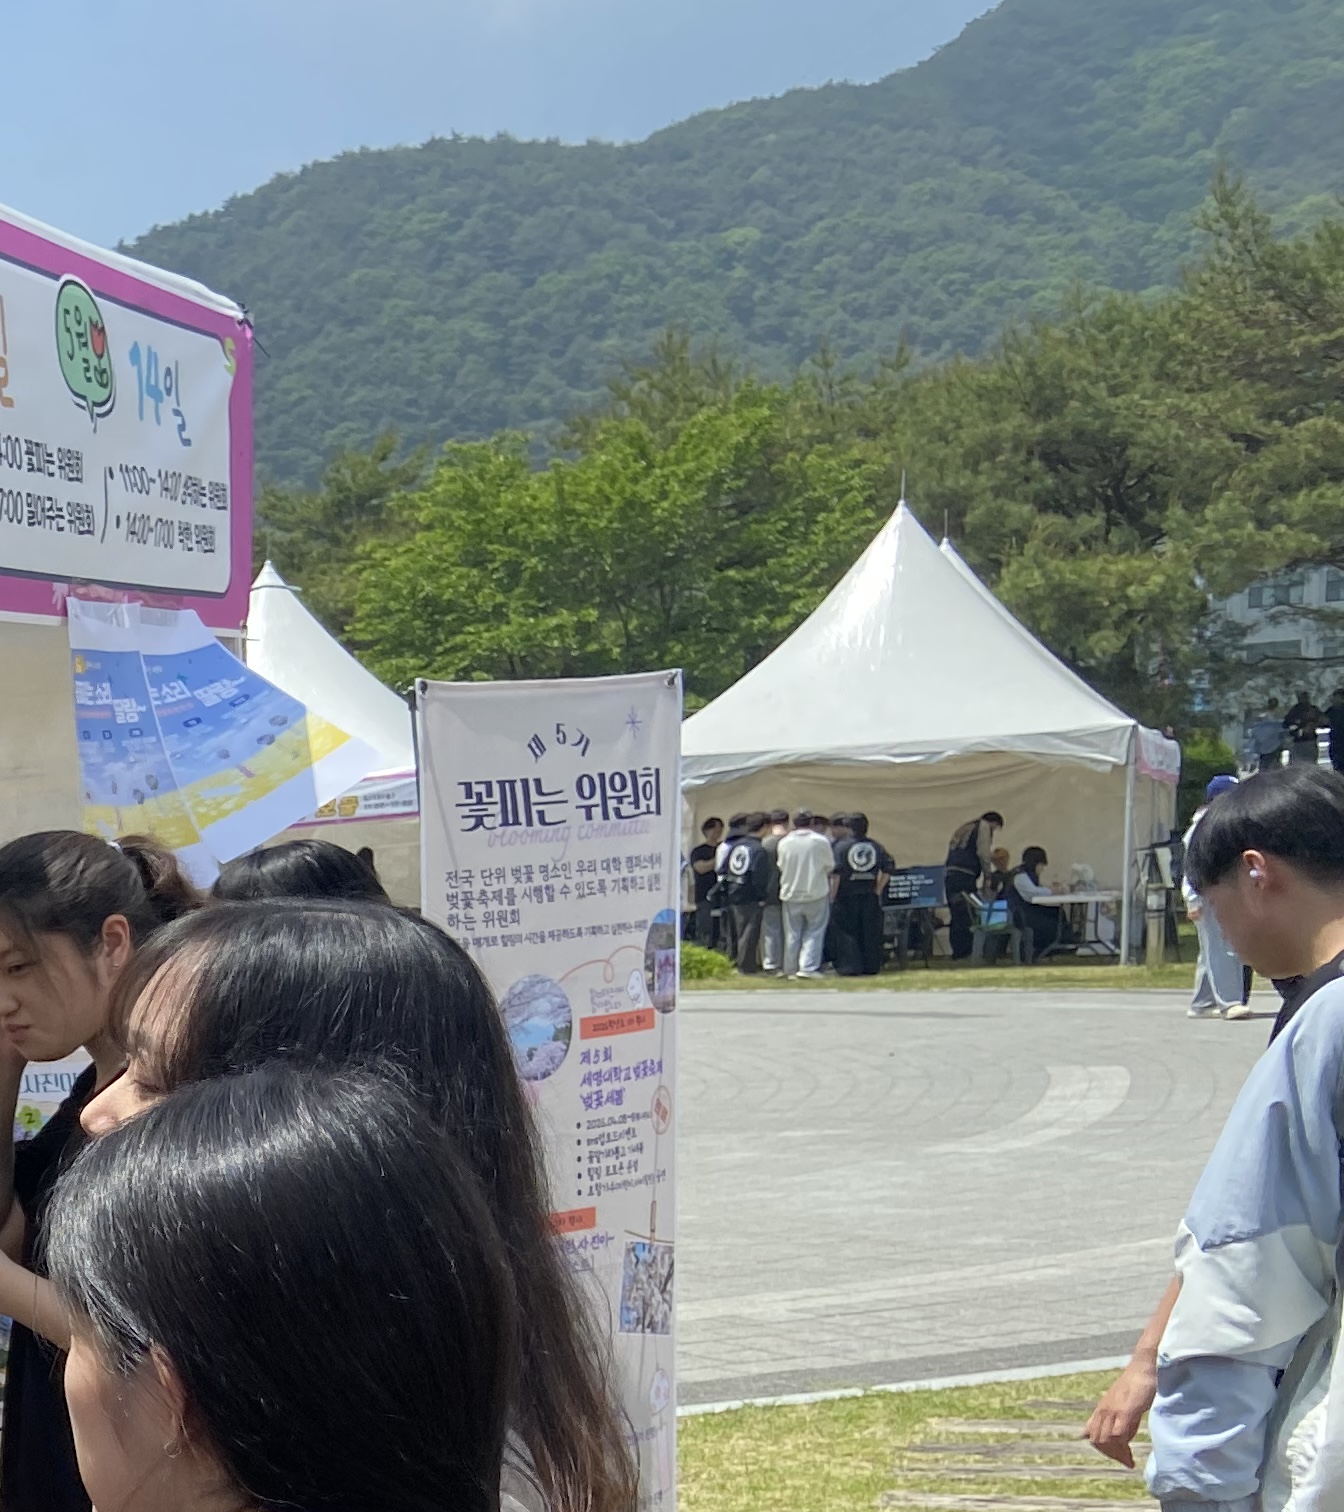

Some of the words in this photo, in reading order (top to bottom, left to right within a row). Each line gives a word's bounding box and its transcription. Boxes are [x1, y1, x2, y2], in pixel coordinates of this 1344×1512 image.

[129, 341, 191, 447] 14일
[24, 438, 55, 477] 꽃피는
[57, 447, 83, 483] 위원회
[67, 501, 95, 536] 위원회
[455, 777, 569, 832] 꽃피는
[575, 767, 661, 822] 위원회
[445, 869, 475, 889] 전국
[480, 867, 506, 887] 단위
[510, 864, 534, 884] 벚꽃
[538, 860, 572, 882] 명소인
[576, 859, 597, 877] 우리
[601, 856, 622, 874] 대학
[560, 882, 571, 900] 수
[574, 878, 608, 899] 있도록
[447, 911, 477, 931] 하는
[482, 908, 520, 929] 위원회
